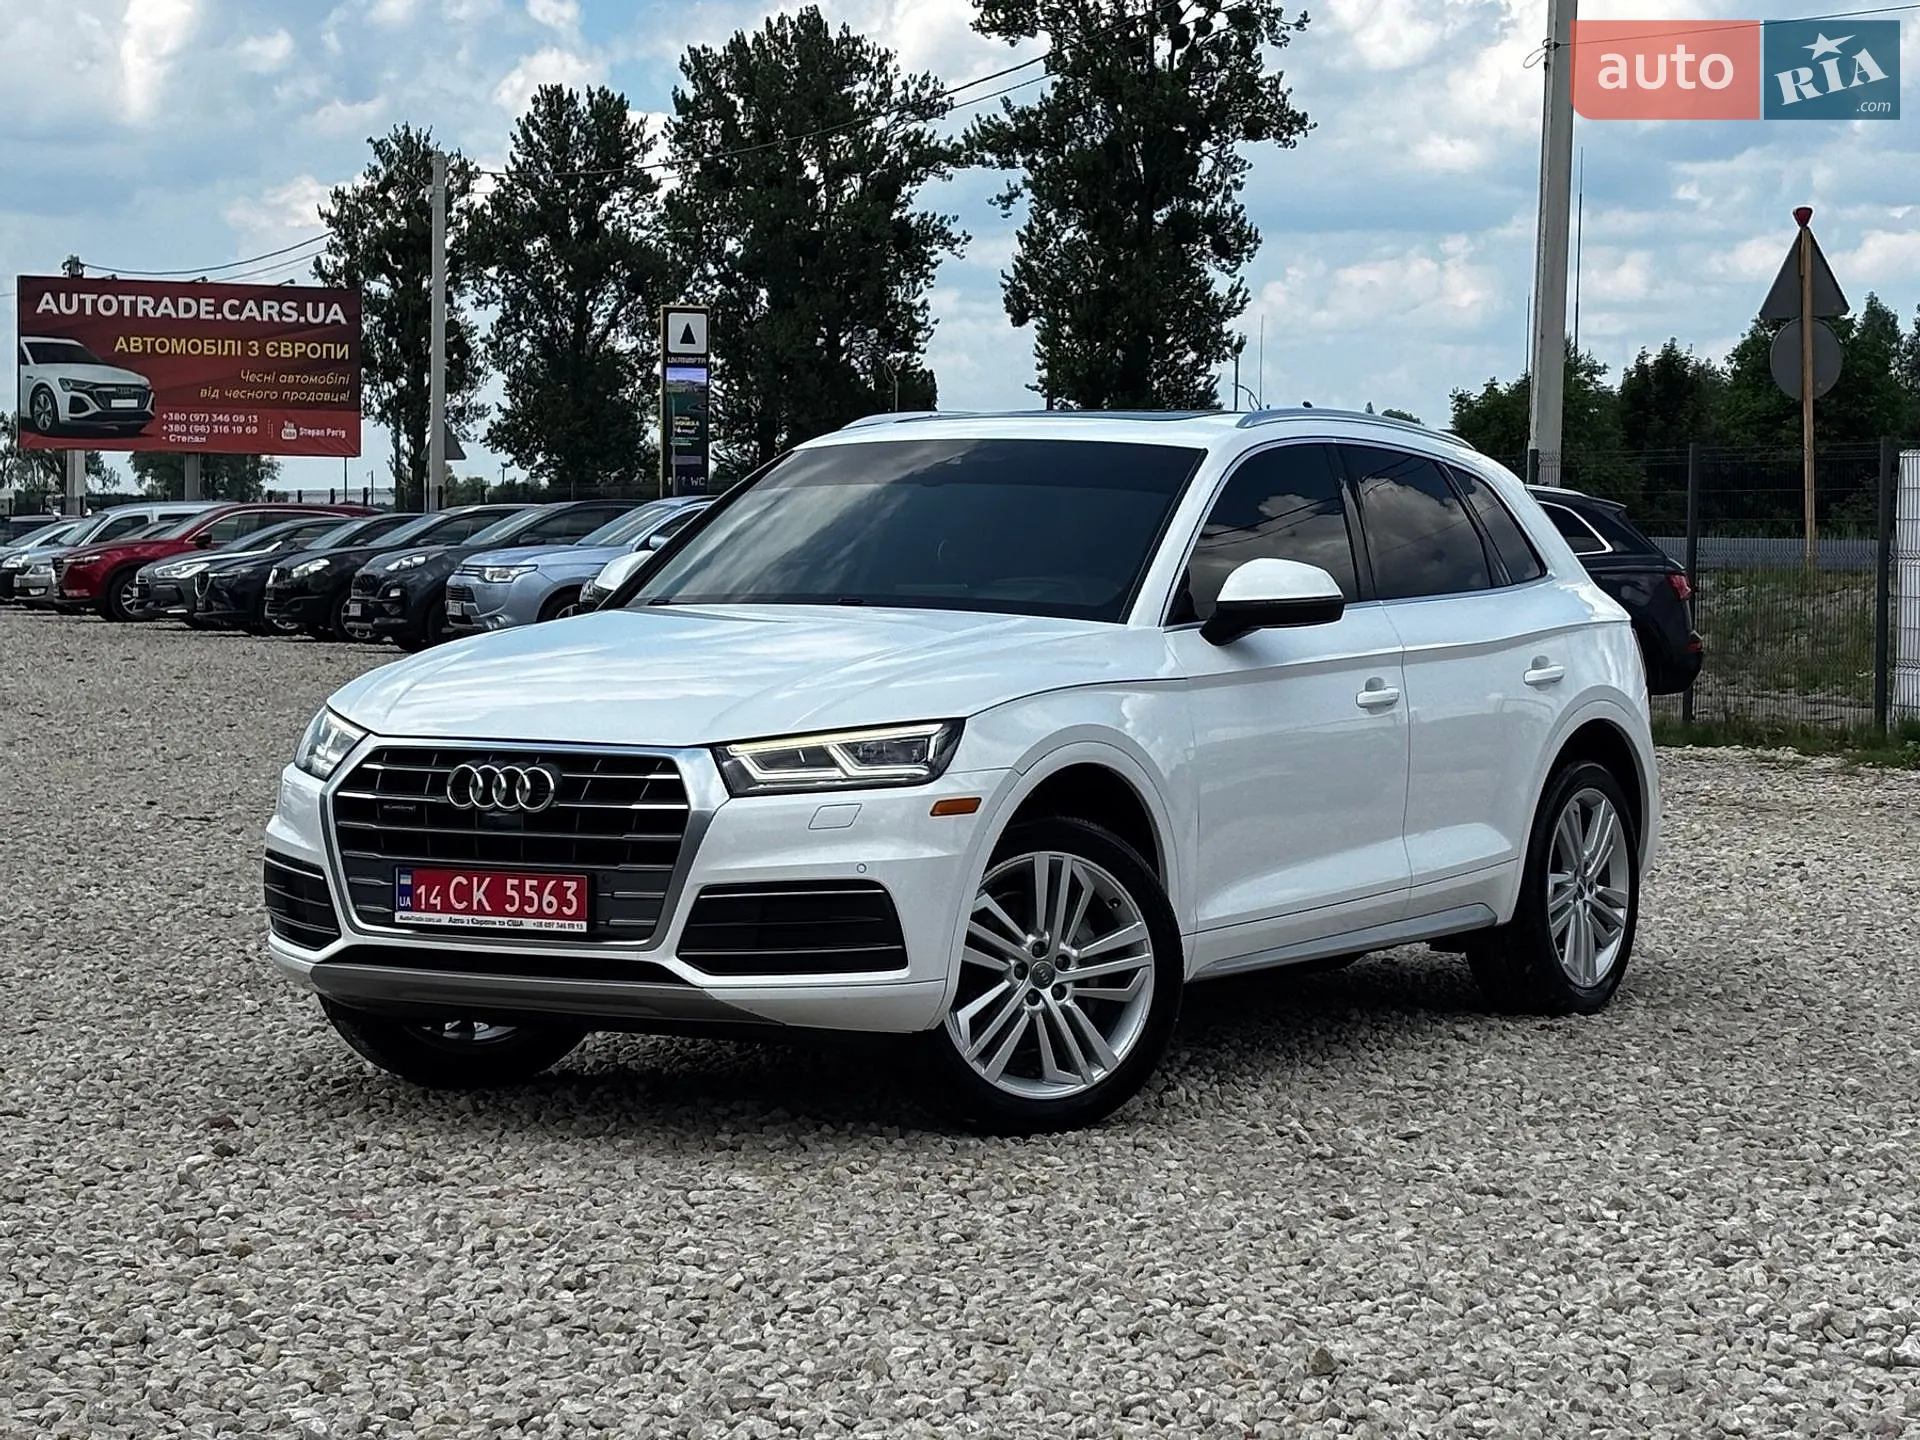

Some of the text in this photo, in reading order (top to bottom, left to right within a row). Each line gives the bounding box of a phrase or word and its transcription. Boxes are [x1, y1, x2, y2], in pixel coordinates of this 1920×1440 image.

[36, 292, 348, 325] AUTOTRADE.CARS.UA
[114, 336, 242, 357] АВТОМОБІЛІ
[265, 341, 350, 361] ЄВРОПИ
[240, 370, 350, 386] Чесні автомобілі
[200, 387, 351, 403] від чесного продавця!
[690, 476, 706, 487] WC
[400, 896, 412, 907] UA
[416, 876, 578, 915] 14 CK 5563
